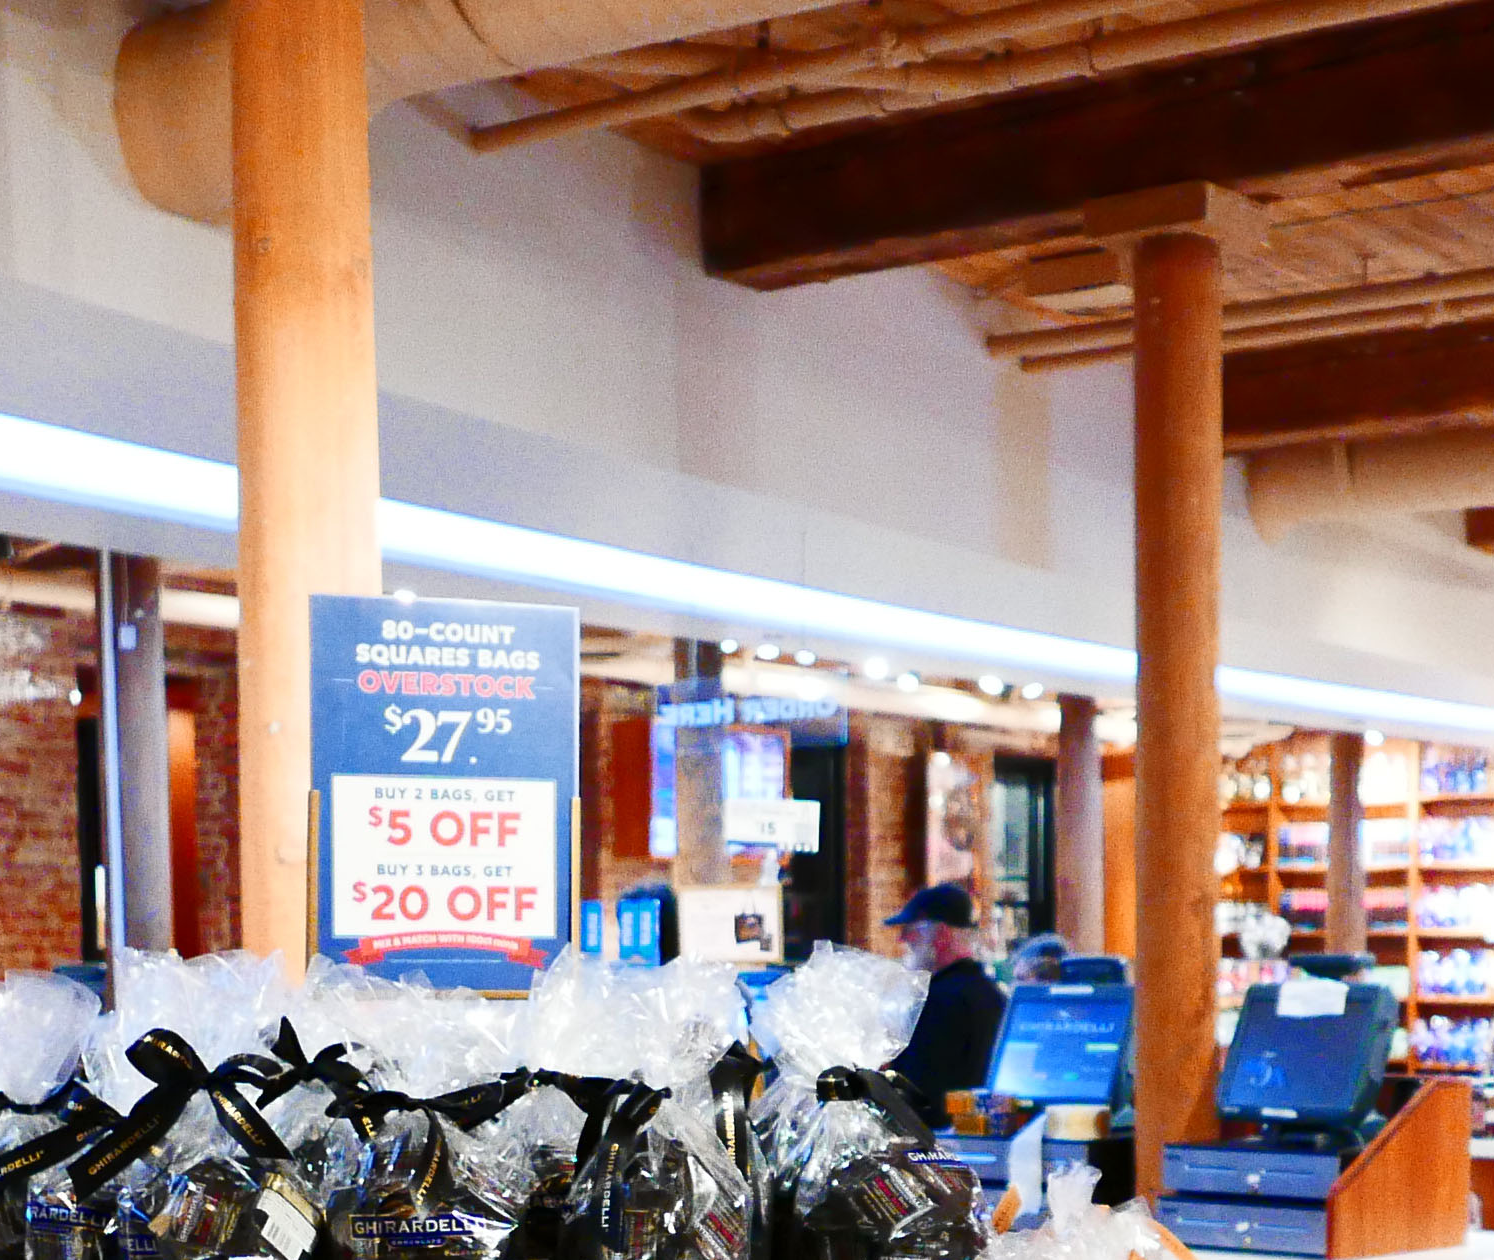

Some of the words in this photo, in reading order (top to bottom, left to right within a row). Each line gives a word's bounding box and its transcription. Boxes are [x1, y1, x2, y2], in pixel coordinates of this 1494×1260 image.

[382, 620, 515, 643] 80-COUNT
[356, 643, 470, 667] SQUARES
[477, 648, 540, 670] BAGS
[358, 670, 535, 698] OVERSTOCK
[374, 787, 406, 800] BUY
[415, 788, 423, 800] 2
[484, 790, 515, 802] GET
[369, 805, 412, 846] $5
[430, 810, 521, 847] OFF
[376, 864, 406, 876] BUY
[415, 865, 424, 876] 3
[483, 866, 513, 877] GET
[353, 881, 429, 921] $20
[447, 886, 538, 922] OFF
[601, 1143, 620, 1229] GHIRARDELLI
[31, 1205, 107, 1227] RARDELLI
[355, 1216, 479, 1235] GHIRARDELL
